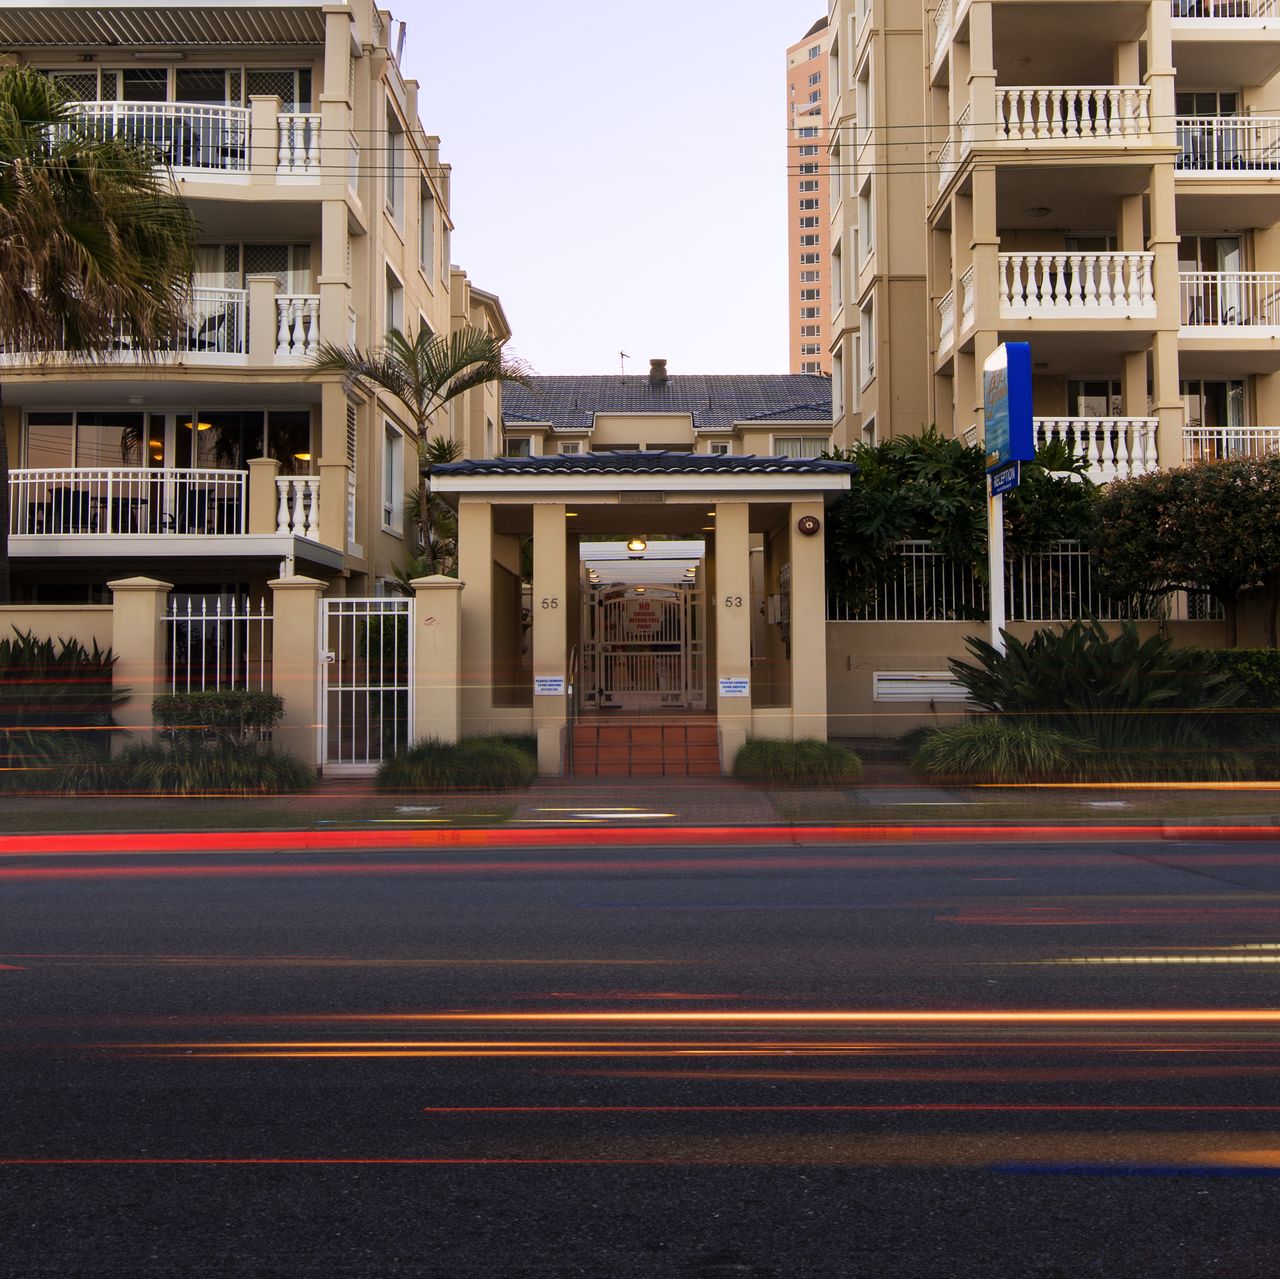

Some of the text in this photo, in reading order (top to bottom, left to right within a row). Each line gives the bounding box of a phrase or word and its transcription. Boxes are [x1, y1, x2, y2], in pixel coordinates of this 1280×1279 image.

[993, 467, 1016, 487] RECEPTION
[541, 597, 559, 609] 55
[639, 602, 650, 610] NO
[725, 596, 742, 608] 53
